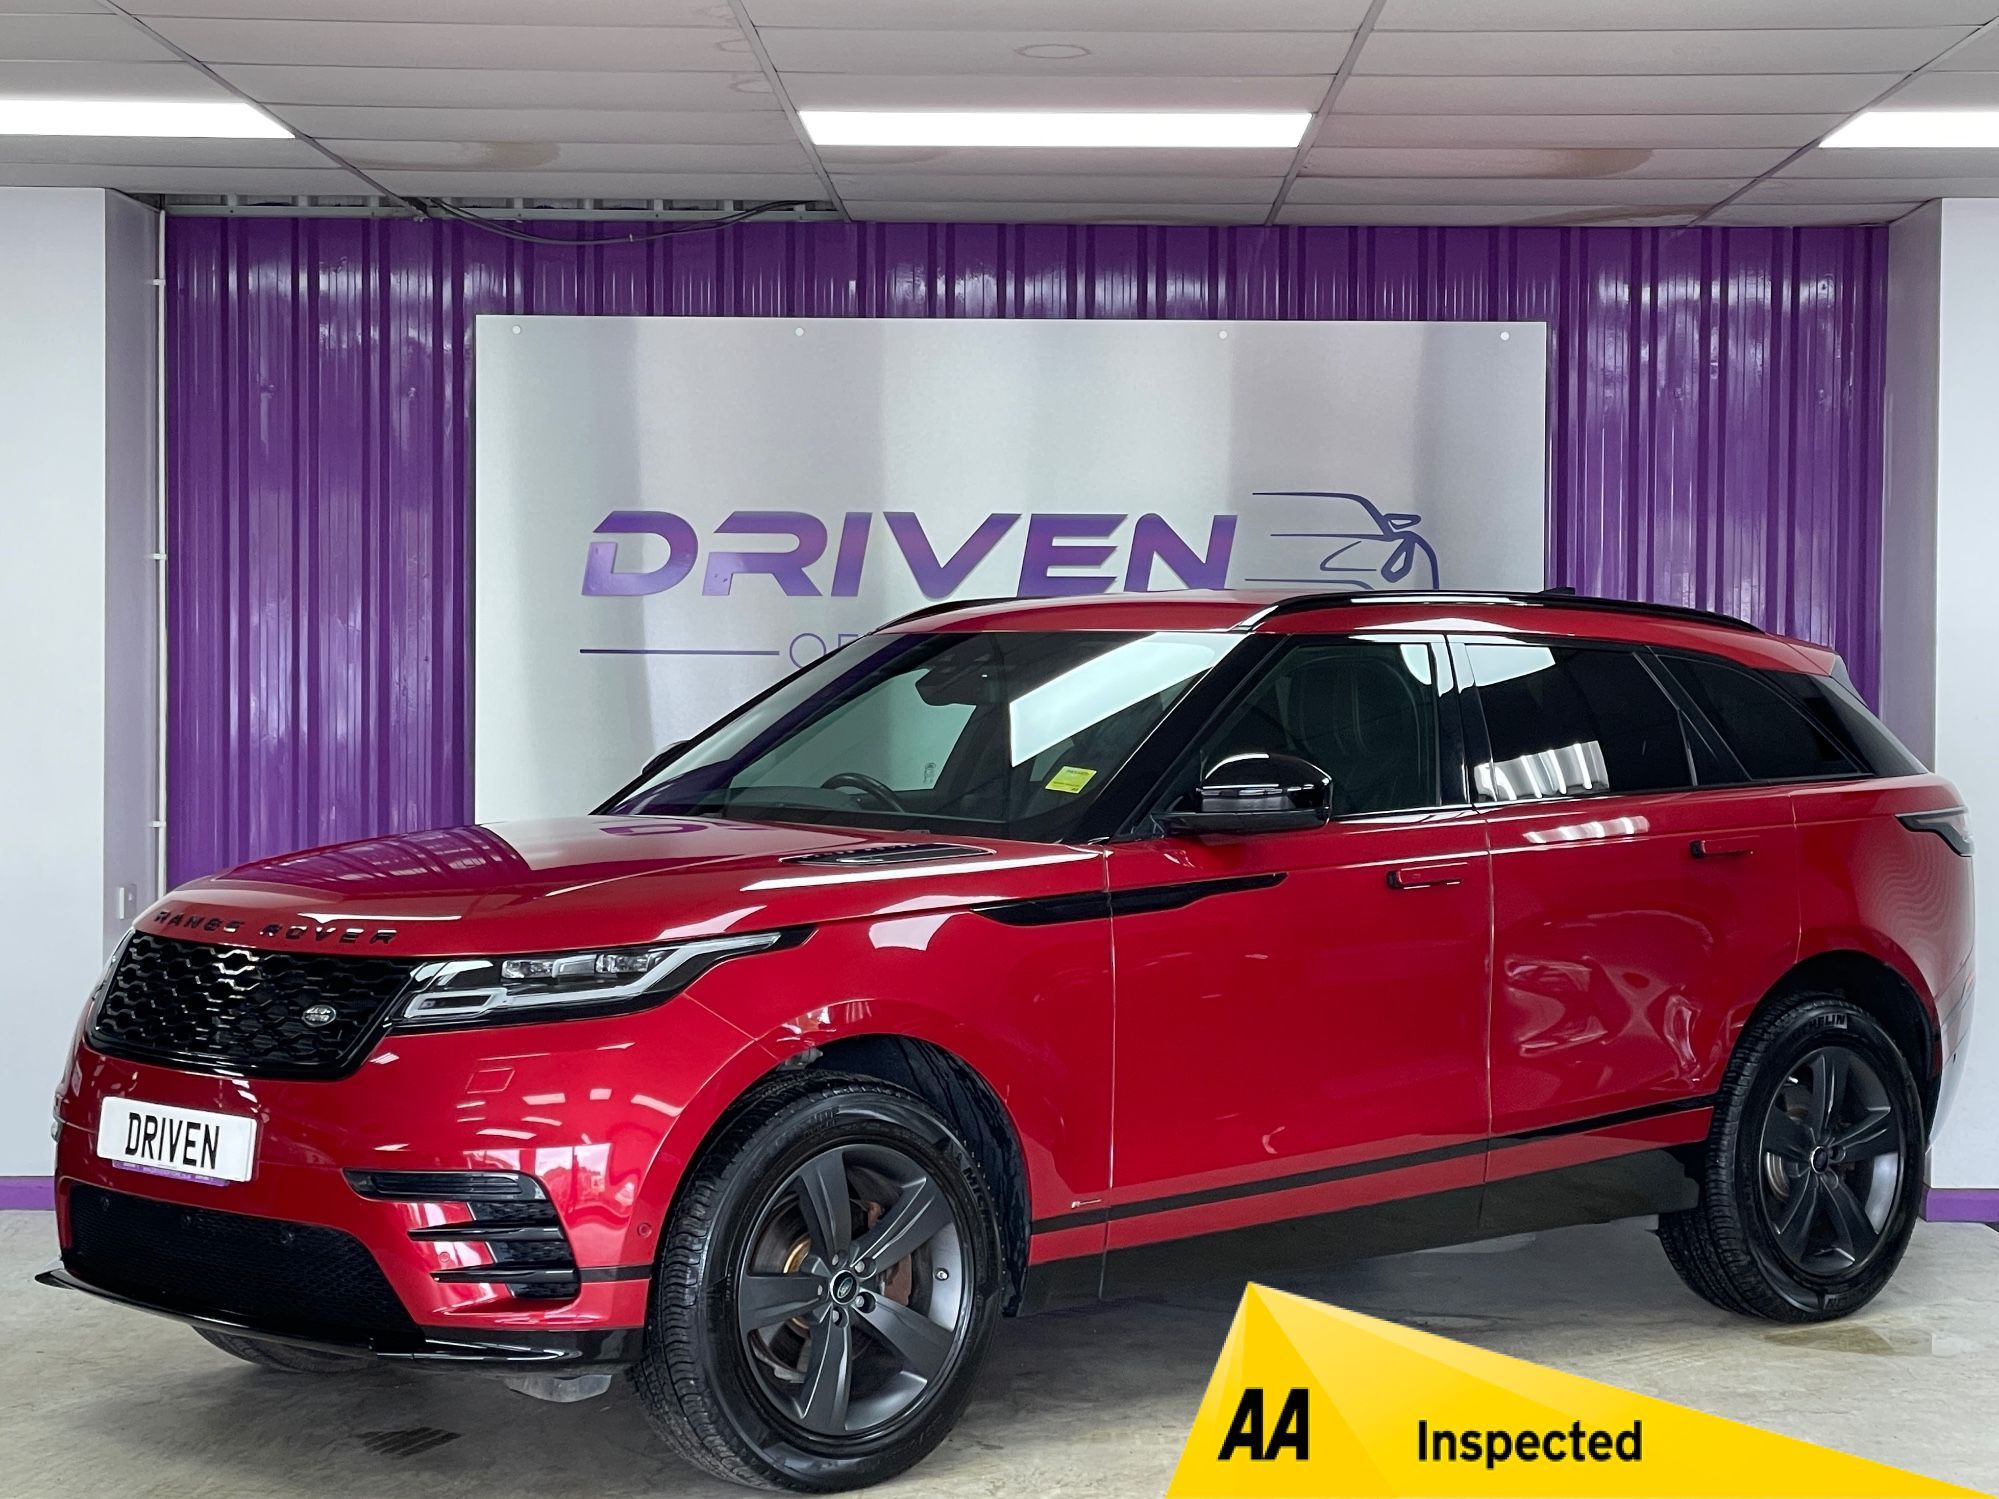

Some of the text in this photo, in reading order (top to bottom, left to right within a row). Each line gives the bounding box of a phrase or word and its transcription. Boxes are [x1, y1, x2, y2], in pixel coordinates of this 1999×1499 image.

[582, 511, 1238, 598] DRIVEN
[259, 923, 398, 944] ROVER
[125, 1112, 220, 1170] DRIVEN
